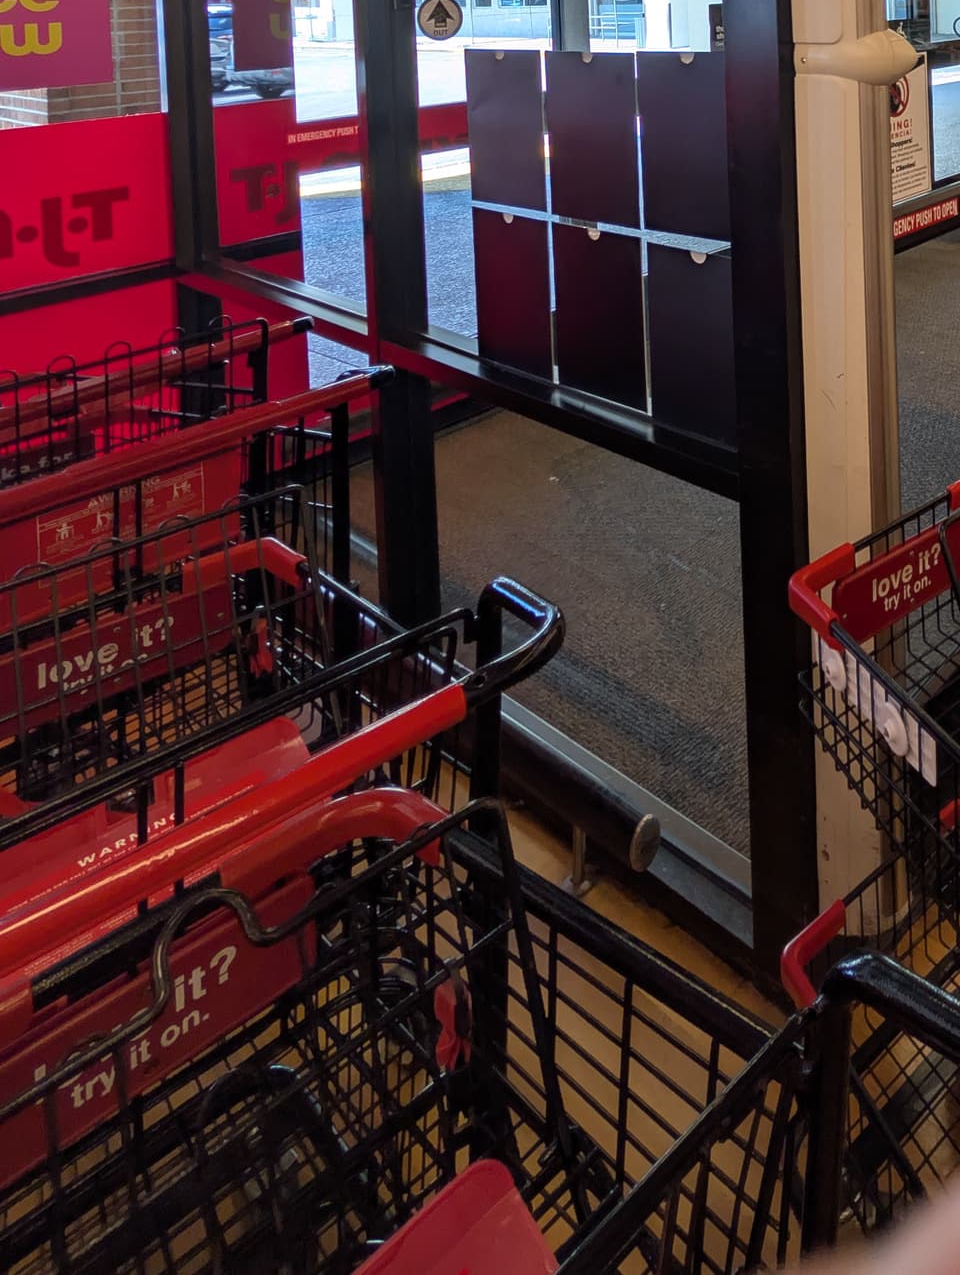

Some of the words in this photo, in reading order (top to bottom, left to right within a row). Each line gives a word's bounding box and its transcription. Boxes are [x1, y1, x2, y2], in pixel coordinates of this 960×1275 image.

[297, 128, 336, 142] EMERGENCY
[893, 217, 914, 237] GENCY
[916, 209, 932, 227] PUSH
[933, 205, 941, 220] TO
[942, 198, 958, 217] OPEN
[872, 564, 913, 603] love
[918, 542, 941, 575] it?
[884, 592, 900, 612] try
[903, 584, 911, 600] it
[914, 576, 931, 593] on.
[37, 643, 119, 690] love
[174, 945, 238, 1013] it?
[71, 1064, 116, 1109] try
[130, 1039, 153, 1070] it
[160, 1009, 211, 1048] on.
